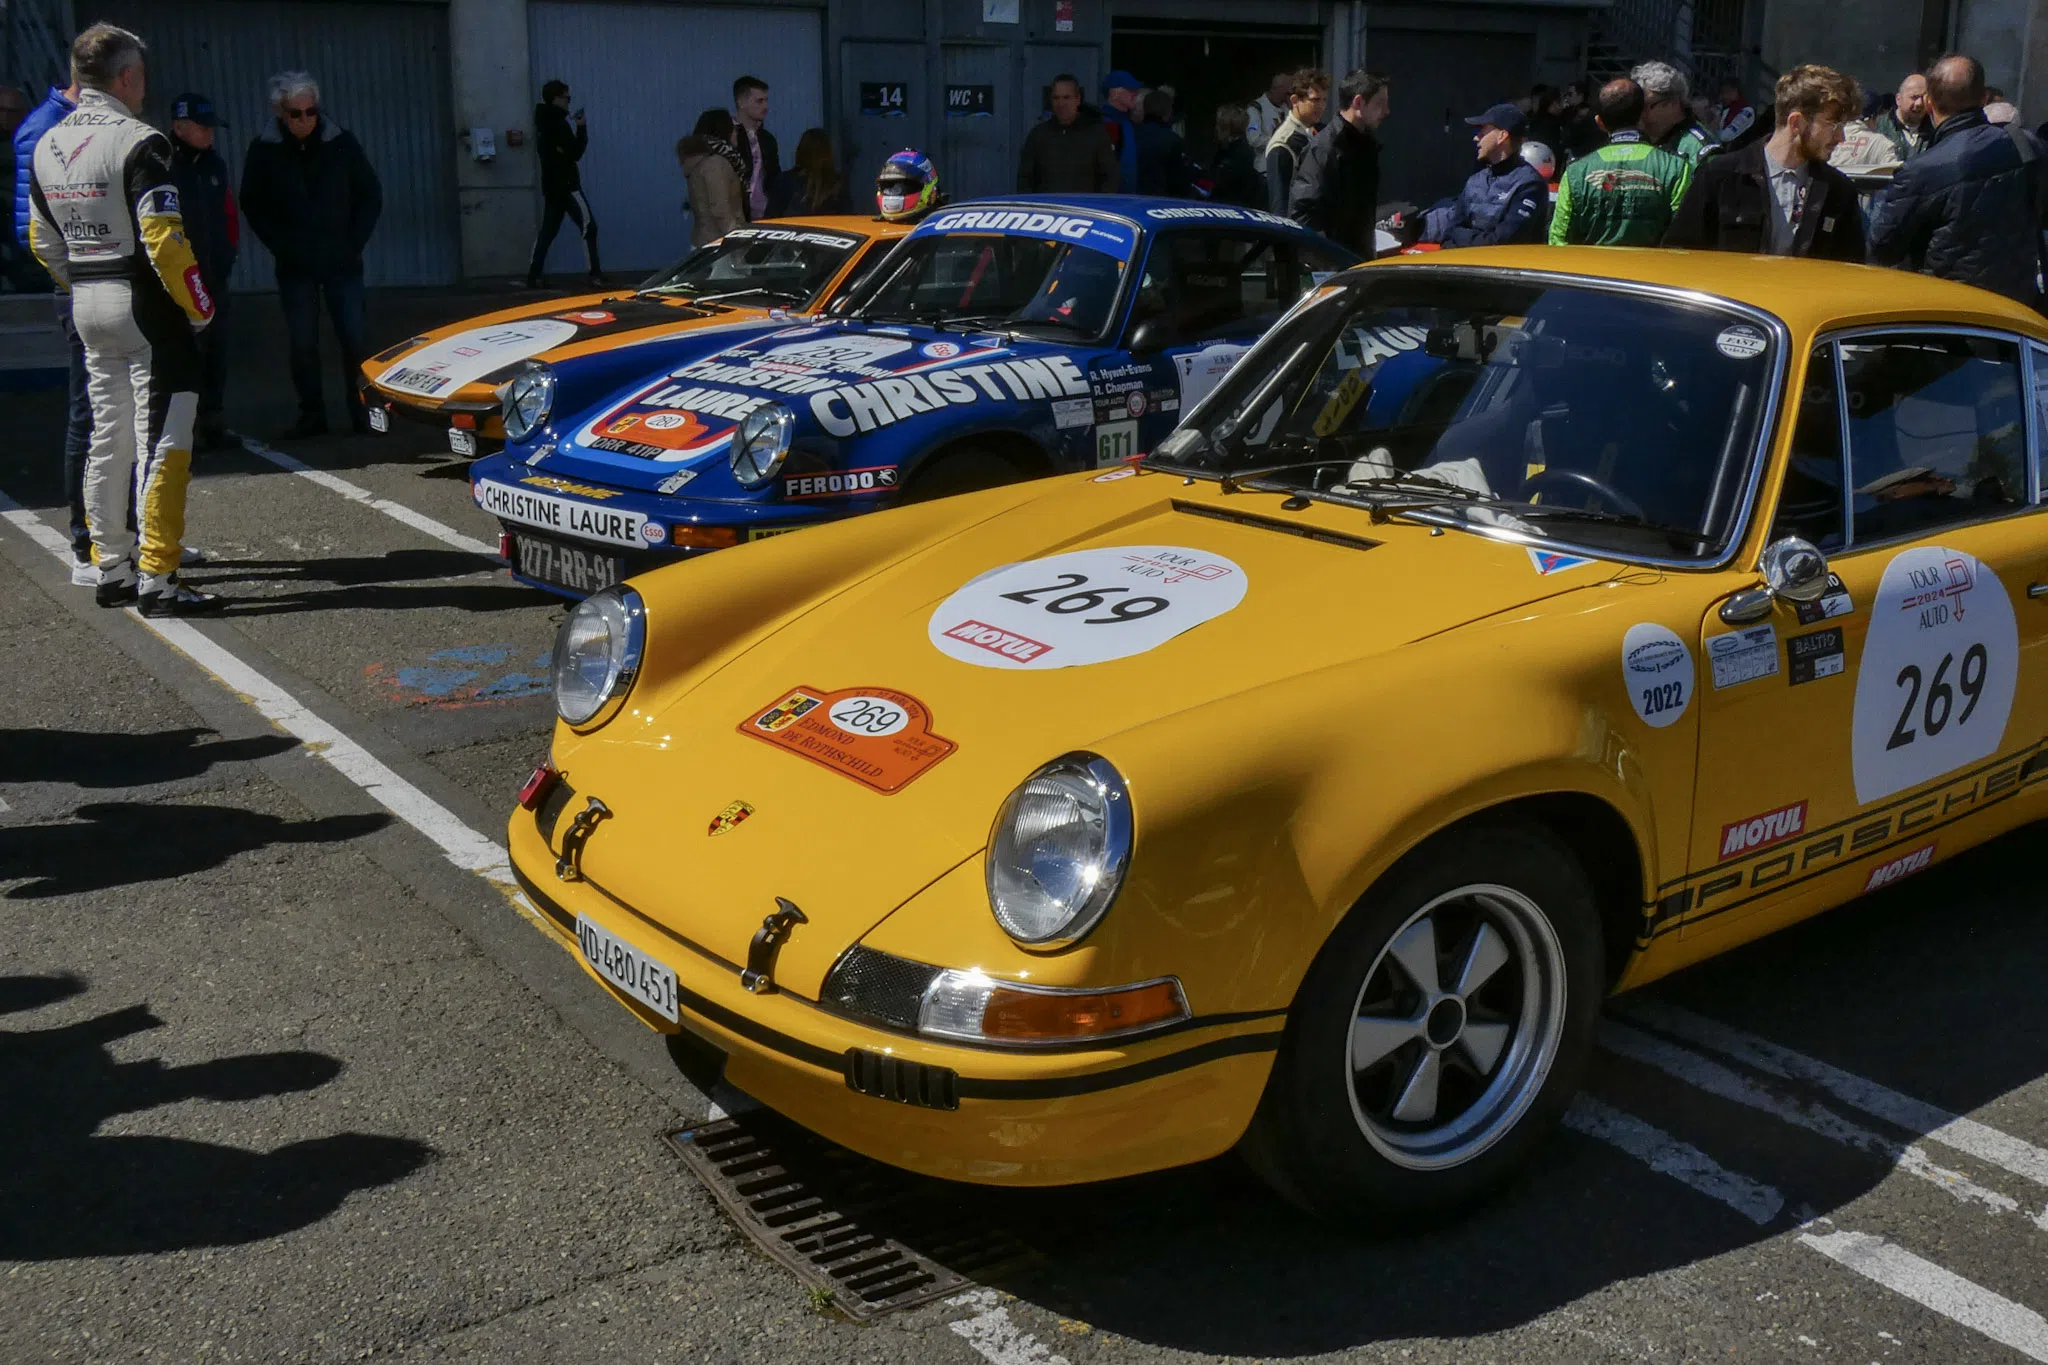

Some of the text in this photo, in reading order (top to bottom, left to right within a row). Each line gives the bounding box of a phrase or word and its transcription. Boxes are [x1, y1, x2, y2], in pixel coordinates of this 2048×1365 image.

[880, 86, 903, 106] 14
[949, 89, 972, 105] WC
[934, 210, 1094, 239] GRUNDIG
[1146, 207, 1245, 220] CHRISTINE
[785, 345, 873, 362] 280
[1101, 362, 1153, 382] Hywel-Evans
[809, 355, 1091, 438] CHRISTINE
[1094, 379, 1144, 396] R. Chapman
[649, 415, 684, 428] 280
[1099, 430, 1133, 461] GT1
[786, 472, 875, 497] FERODO
[485, 486, 561, 526] CHRISTINE
[569, 506, 637, 542] LAURE
[1120, 564, 1164, 578] AUTO
[1152, 552, 1197, 567] TOUR
[1908, 566, 1942, 589] TOUR
[998, 573, 1171, 625] 269
[1916, 588, 1945, 606] 2024
[1919, 604, 1949, 630] AUTO
[951, 623, 1043, 659] MOTUL
[1642, 681, 1684, 716] 2022
[1885, 643, 1988, 752] 269
[831, 699, 901, 733] 269
[798, 717, 856, 746] EDMOND
[780, 729, 801, 742] DE
[801, 735, 884, 778] ROTHSCHILD
[1696, 763, 2019, 909] PORSCHE
[1722, 804, 1802, 857] MOTUL
[1865, 846, 1936, 893] MOTUL
[578, 918, 673, 1014] VD 480 451
